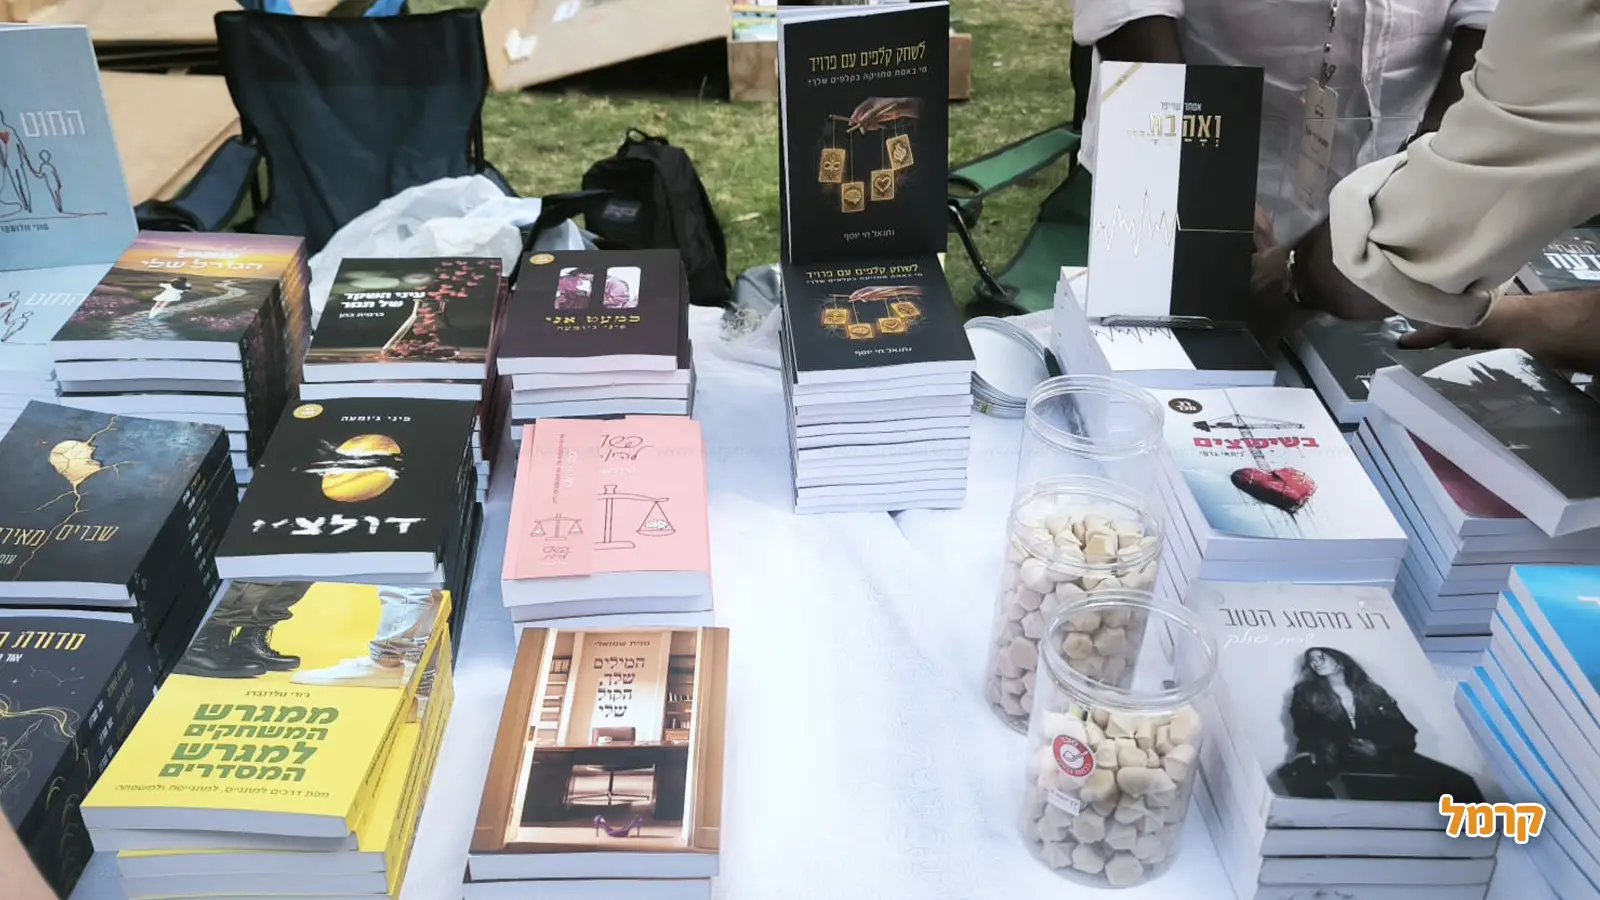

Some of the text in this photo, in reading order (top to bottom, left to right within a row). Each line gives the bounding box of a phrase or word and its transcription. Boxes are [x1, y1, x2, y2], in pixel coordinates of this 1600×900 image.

[809, 41, 926, 72] לשחק קלפים עם פרויד
[20, 110, 86, 138] החוט
[141, 258, 187, 269] שלי
[805, 264, 919, 279] לשחק קלפים עם פרויד
[344, 291, 426, 300] עיני השקד
[378, 300, 404, 308] של
[545, 315, 640, 324] כמעט אני
[1193, 436, 1319, 449] בשיפוצים
[55, 524, 119, 541] שברים
[1219, 608, 1391, 629] רע מהסוג הטוב
[11, 631, 87, 650] מדורת
[593, 656, 645, 669] המילים
[599, 672, 636, 686] שלך,
[597, 688, 633, 702] הקול
[193, 703, 339, 725] ממגרש
[598, 704, 628, 718] שלי
[183, 723, 329, 741] המשחקים
[171, 741, 318, 765] למגרש
[158, 763, 307, 782] המסדרים
